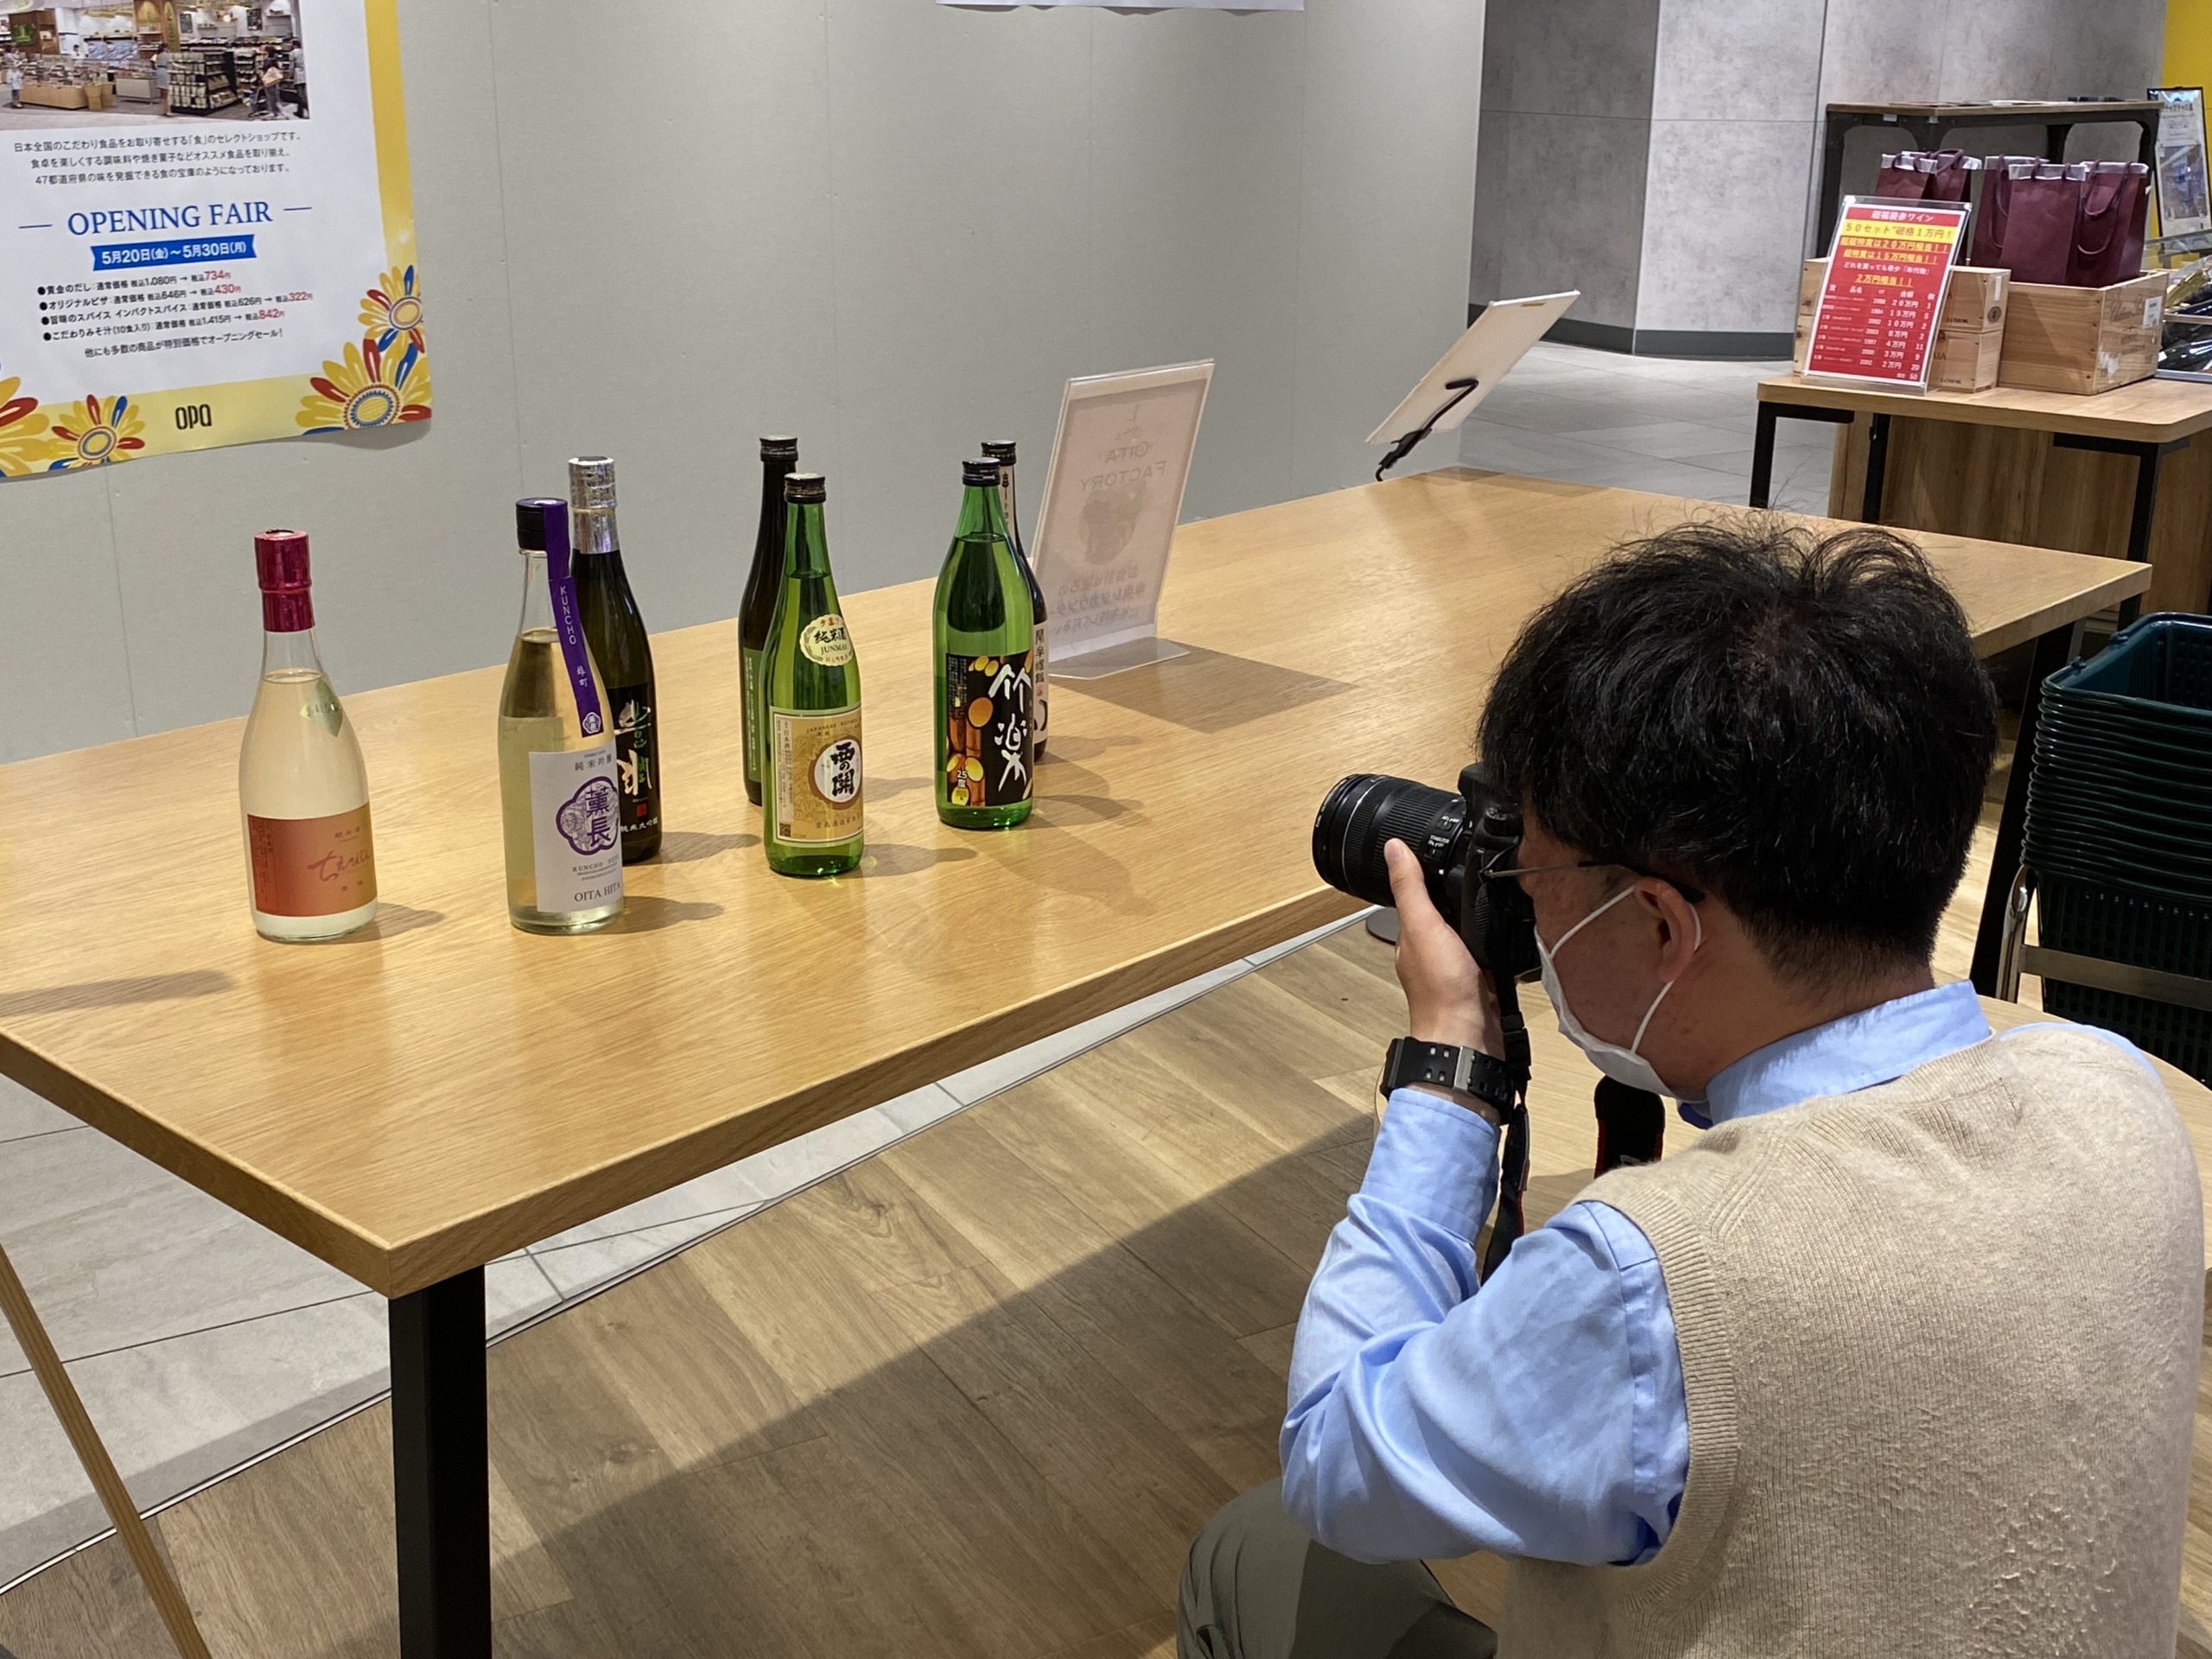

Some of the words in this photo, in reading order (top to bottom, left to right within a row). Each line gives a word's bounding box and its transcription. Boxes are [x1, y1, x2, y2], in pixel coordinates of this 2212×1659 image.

[68, 205, 201, 235] OPENING
[208, 201, 273, 226] FAIR
[560, 585, 577, 645] KUNCHO
[572, 861, 603, 873] KUNCHO
[574, 888, 602, 903] OITA
